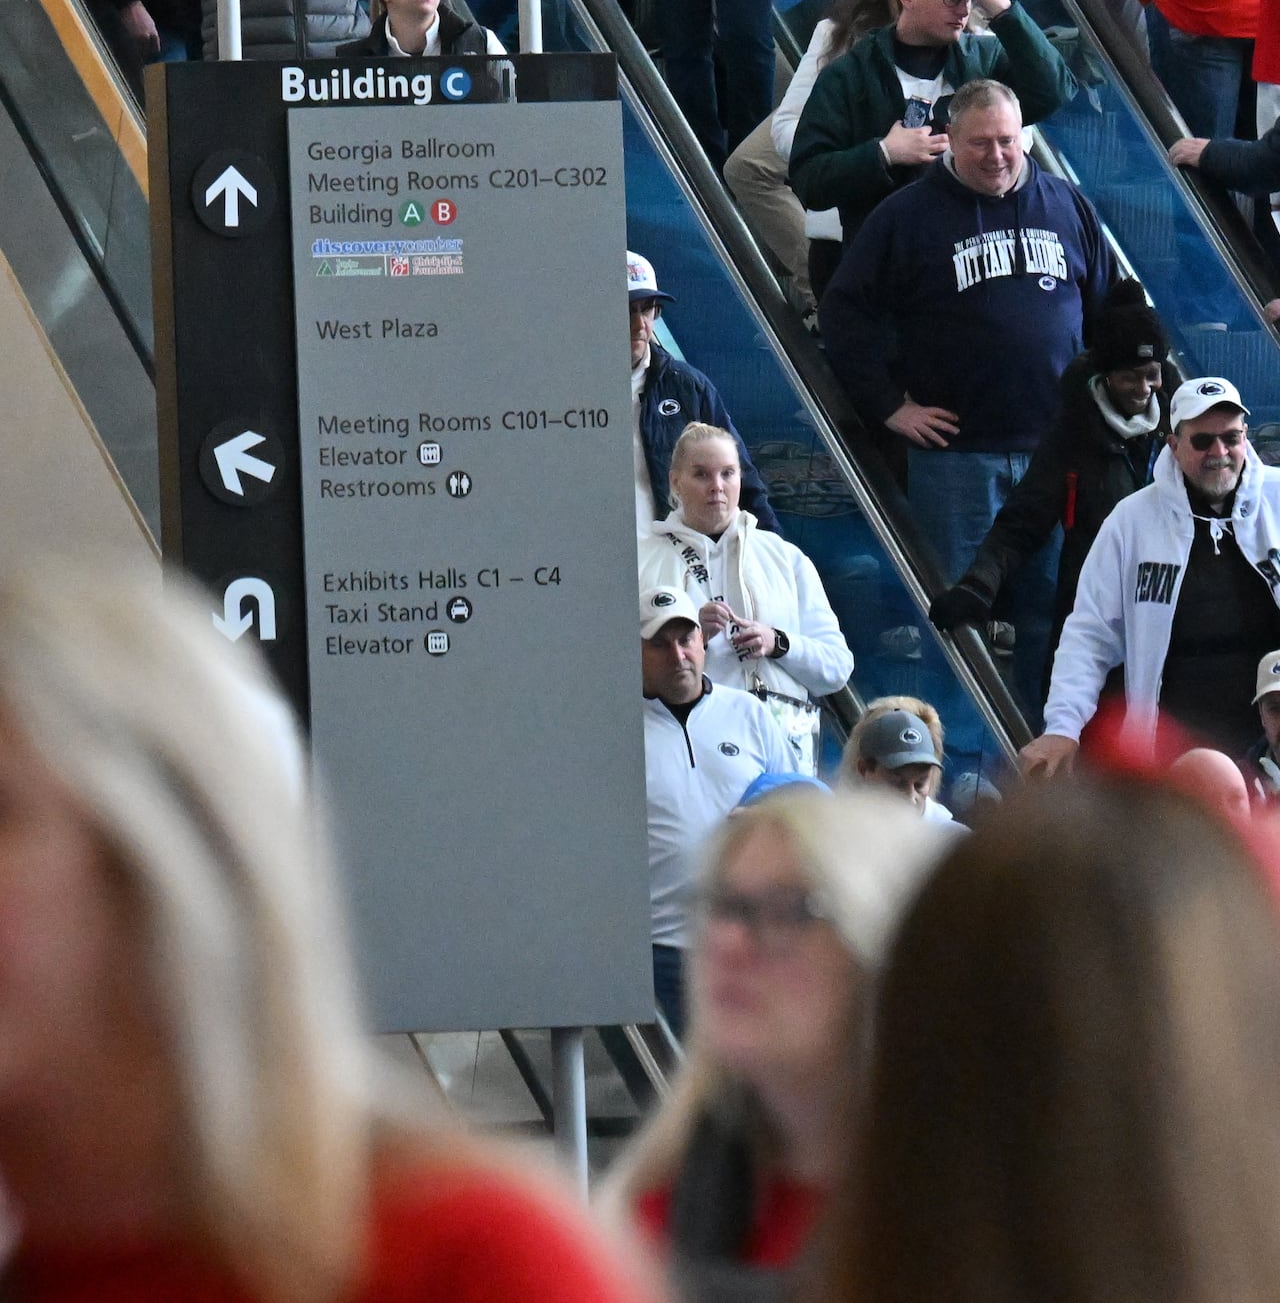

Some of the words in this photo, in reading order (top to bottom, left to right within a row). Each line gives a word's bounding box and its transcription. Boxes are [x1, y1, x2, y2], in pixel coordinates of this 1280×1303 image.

[281, 67, 433, 105] Building
[307, 141, 392, 164] Georgia
[401, 139, 495, 159] Ballroom
[308, 171, 399, 196] Meeting
[408, 171, 479, 191] Rooms
[310, 204, 393, 226] Building
[1020, 237, 1068, 282] LIONS
[316, 319, 372, 340] West
[382, 317, 439, 339] Plaza
[318, 414, 410, 437] Meeting
[419, 413, 491, 432] Rooms
[319, 446, 408, 466] Elevator
[320, 478, 437, 498] Restrooms
[682, 546, 701, 565] WE
[323, 570, 409, 592] Exhibits
[419, 568, 468, 589] Halls
[476, 568, 500, 588] C1
[533, 566, 561, 586] C4
[690, 563, 709, 585] ARE
[324, 603, 369, 624] Taxi
[378, 601, 439, 622] Stand
[325, 635, 415, 655] Elevator
